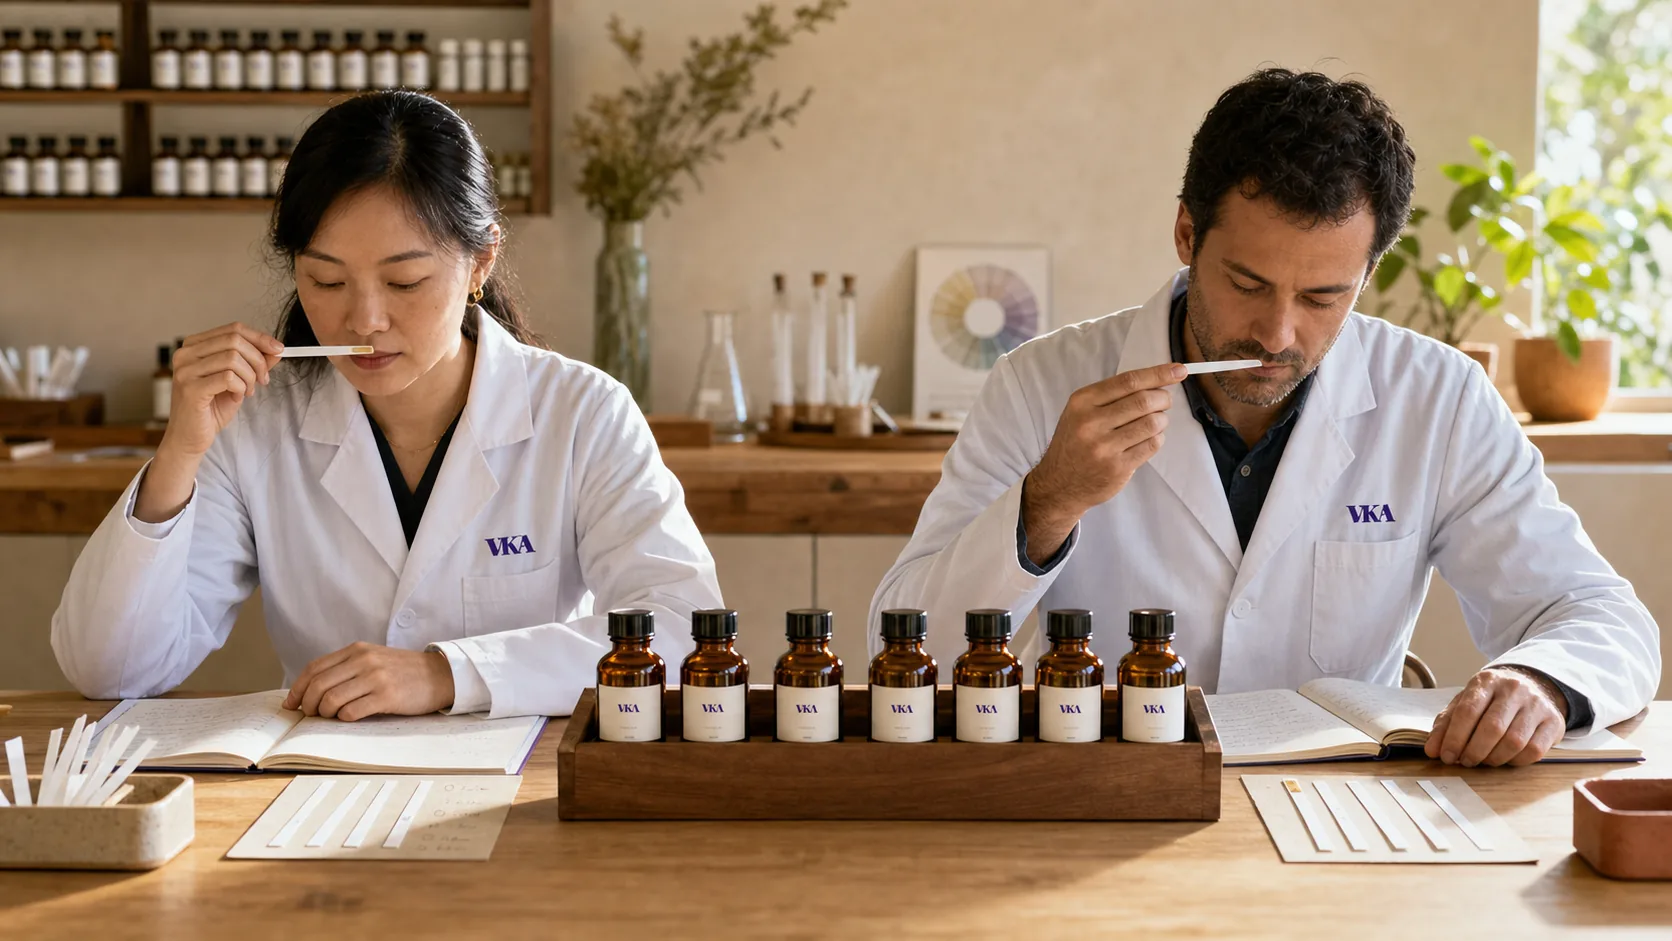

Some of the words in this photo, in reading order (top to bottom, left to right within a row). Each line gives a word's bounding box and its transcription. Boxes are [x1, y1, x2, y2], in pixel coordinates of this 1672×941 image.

[1346, 504, 1396, 523] VKA
[484, 535, 536, 556] VKA
[618, 704, 640, 713] VKA
[702, 704, 724, 713] VKA
[796, 704, 818, 713] VKA
[891, 704, 913, 713] VKA
[976, 705, 998, 714] VKA
[1060, 705, 1081, 714] VKA
[1143, 705, 1165, 714] VKA
